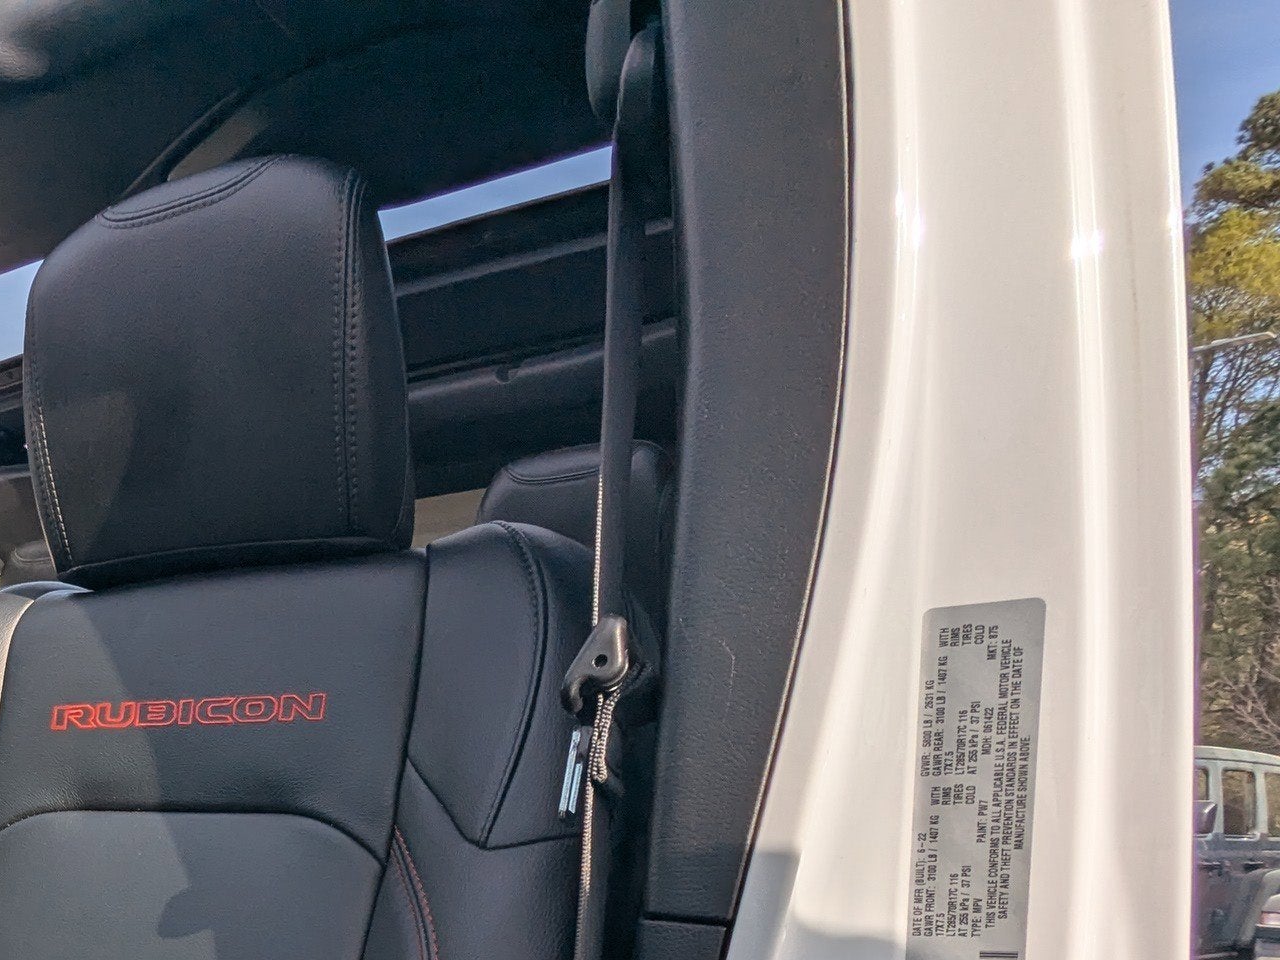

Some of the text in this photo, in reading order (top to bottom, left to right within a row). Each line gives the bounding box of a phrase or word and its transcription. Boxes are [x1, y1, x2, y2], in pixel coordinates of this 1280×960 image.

[939, 628, 949, 647] WITH
[962, 624, 972, 645] TIRES
[974, 625, 985, 645] COLD
[987, 641, 997, 660] MKT:
[938, 656, 947, 666] KG
[925, 680, 934, 689] KG
[937, 696, 945, 704] LB
[944, 628, 959, 775] 17X7.5 RIMS
[971, 701, 980, 713] PSI
[50, 692, 328, 731] RUBICON
[936, 708, 945, 724] 3100
[970, 716, 979, 724] 37
[923, 719, 932, 728] LB
[933, 729, 944, 752] REAR:
[969, 735, 978, 747] kPa
[981, 736, 991, 754] MDH:
[921, 753, 930, 776] GVWR:
[932, 754, 942, 776] GAWR
[969, 750, 977, 762] 255
[967, 766, 976, 774] AT
[985, 640, 1011, 928] THIS VEHICLE CONFORMS TO ALL APPLICABLE U.S.A. FEDERAL MOTOR VEHICLE
[998, 647, 1023, 919] SAFETY AND THEFT PREVENTION STANDARDS IN EFFECT ON THE DATE OF
[930, 787, 940, 805] WITH
[954, 784, 963, 804] TIRES
[966, 786, 976, 804] COLD
[1014, 736, 1030, 849] MANUFACTURE SHOWN ABOVE.
[930, 815, 939, 824] KG
[977, 800, 988, 843] PAINT: PW7
[929, 854, 937, 863] LB
[936, 787, 951, 936] 17X7.5 RIMS
[915, 858, 926, 886] (BUILT):
[928, 865, 937, 881] 3100
[962, 866, 971, 877] PSI
[961, 880, 970, 888] 37
[915, 889, 923, 903] MFR
[926, 887, 936, 912] FRONT:
[961, 898, 969, 911] kPa
[914, 906, 922, 915] OF
[971, 898, 982, 937] TYPE: MPV
[912, 918, 922, 936] DATE
[924, 915, 933, 937] GAWR
[958, 928, 967, 937] AT
